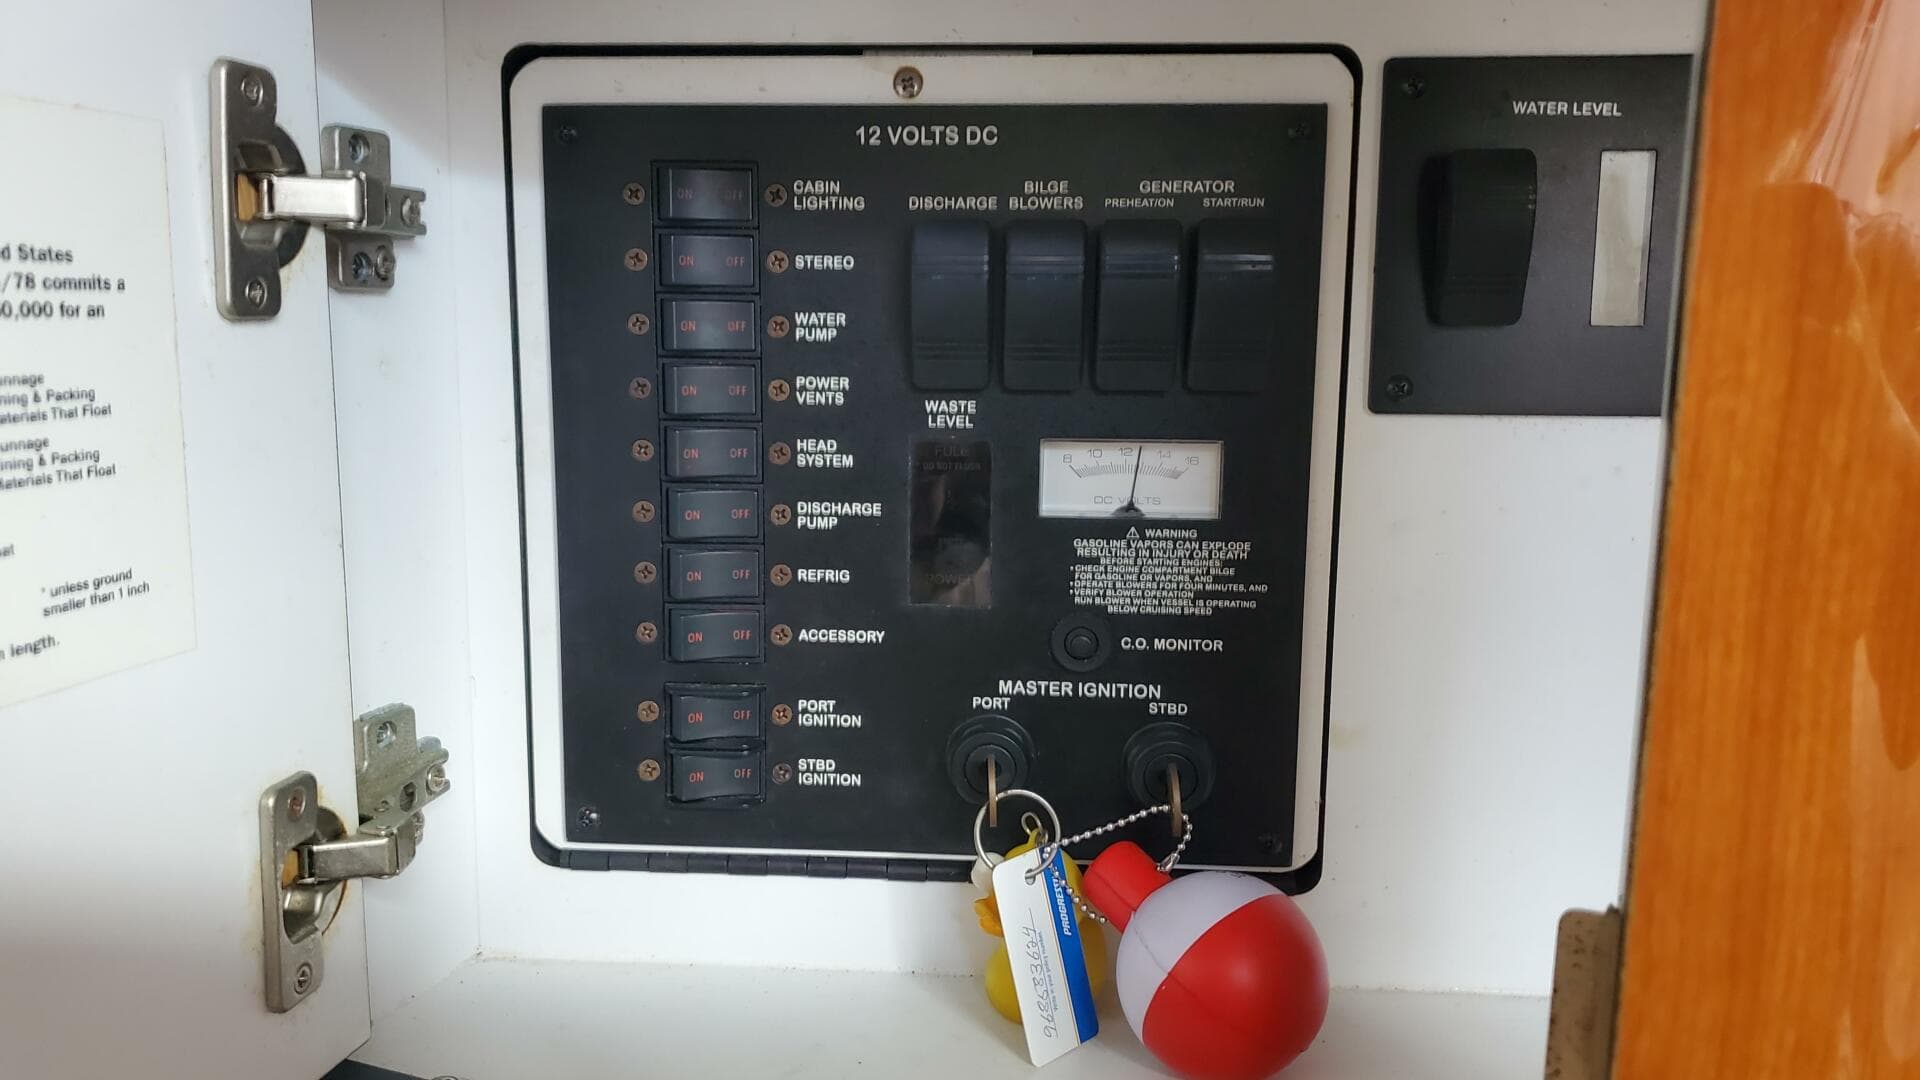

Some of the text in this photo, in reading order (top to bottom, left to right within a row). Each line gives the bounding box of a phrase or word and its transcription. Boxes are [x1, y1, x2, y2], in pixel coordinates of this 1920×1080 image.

[1512, 100, 1623, 117] WATER LEVEL
[856, 125, 998, 146] 12 VOLTS DC
[793, 179, 841, 195] CABIN
[1024, 180, 1070, 195] BILGE
[1139, 180, 1236, 194] GENERATOR
[793, 196, 866, 212] LIGHTING
[908, 195, 998, 211] DISCHARGE
[1009, 196, 1084, 211] BLOWERS
[1104, 198, 1175, 208] PREHEAT/ON
[1203, 198, 1265, 208] START/RUN
[18, 244, 73, 263] States
[678, 255, 745, 267] ON OFF
[795, 255, 855, 270] STEREO
[42, 274, 111, 291] commits
[117, 278, 126, 291] a
[60, 300, 80, 318] for
[87, 305, 105, 318] an
[680, 320, 747, 332] ON OFF
[795, 312, 847, 327] WATER
[795, 328, 838, 342] PUMP
[795, 376, 850, 390] POWER
[46, 388, 96, 402] Packing
[681, 385, 748, 396] ON OFF
[795, 391, 845, 406] VENTS
[51, 405, 79, 420] That
[82, 404, 112, 417] Float
[925, 399, 977, 414] WASTE
[928, 415, 974, 429] LEVEL
[796, 438, 838, 453] HEAD
[51, 449, 101, 465] Packing
[683, 448, 748, 459] ON OFF
[1063, 447, 1200, 466] 8 10 12 14 16
[796, 454, 854, 468] SYSTEM
[56, 468, 84, 483] That
[87, 463, 117, 479] Float
[1093, 495, 1162, 506] DC VOLTS
[684, 508, 751, 521] ON OFF
[797, 502, 882, 517] DISCHARGE
[797, 516, 838, 530] PUMP
[1144, 529, 1198, 539] WARNING
[1073, 538, 1252, 551] GASOLINE VAPORS CAN EXPLODE
[1077, 548, 1248, 560] RESULTING IN INJURY OR DEATH
[1100, 557, 1135, 566] BEFORE
[1136, 558, 1179, 567] STARTING
[686, 569, 751, 582] ON OFF
[797, 568, 851, 584] REFRIG
[1074, 564, 1236, 576] CHECK ENGINE COMPARTMENT BILGE
[50, 568, 133, 598] unless ground
[1074, 572, 1093, 581] FOR
[1094, 573, 1139, 582] GASOLINE
[1140, 574, 1153, 582] OR
[1194, 575, 1213, 583] AND
[1074, 580, 1114, 589] OPERATE
[1115, 581, 1158, 590] BLOWERS
[1160, 582, 1177, 590] FOR
[1179, 582, 1204, 591] FOUR
[1248, 584, 1268, 593] AND
[1074, 588, 1194, 599] VERIFY BLOWER OPERATION
[43, 581, 150, 617] smaller than 1 inch
[1074, 596, 1257, 609] RUN BLOWER WHEN VESSEL IS OPERATING
[1107, 604, 1213, 616] BELOW CRUISING SPEED
[687, 630, 752, 643] ON OFF
[798, 628, 886, 644] ACCESSORY
[10, 635, 61, 658] length.
[1121, 637, 1224, 652] C.O. MONITOR
[998, 680, 1162, 699] MASTER IGNITION
[798, 699, 836, 713] PORT
[972, 696, 1011, 711] PORT
[1148, 702, 1188, 715] STBD
[687, 709, 752, 724] ON OFF
[798, 713, 862, 728] IGNITION
[798, 758, 836, 772] STBD
[689, 768, 752, 783] ON OFF
[798, 773, 862, 787] IGNITION
